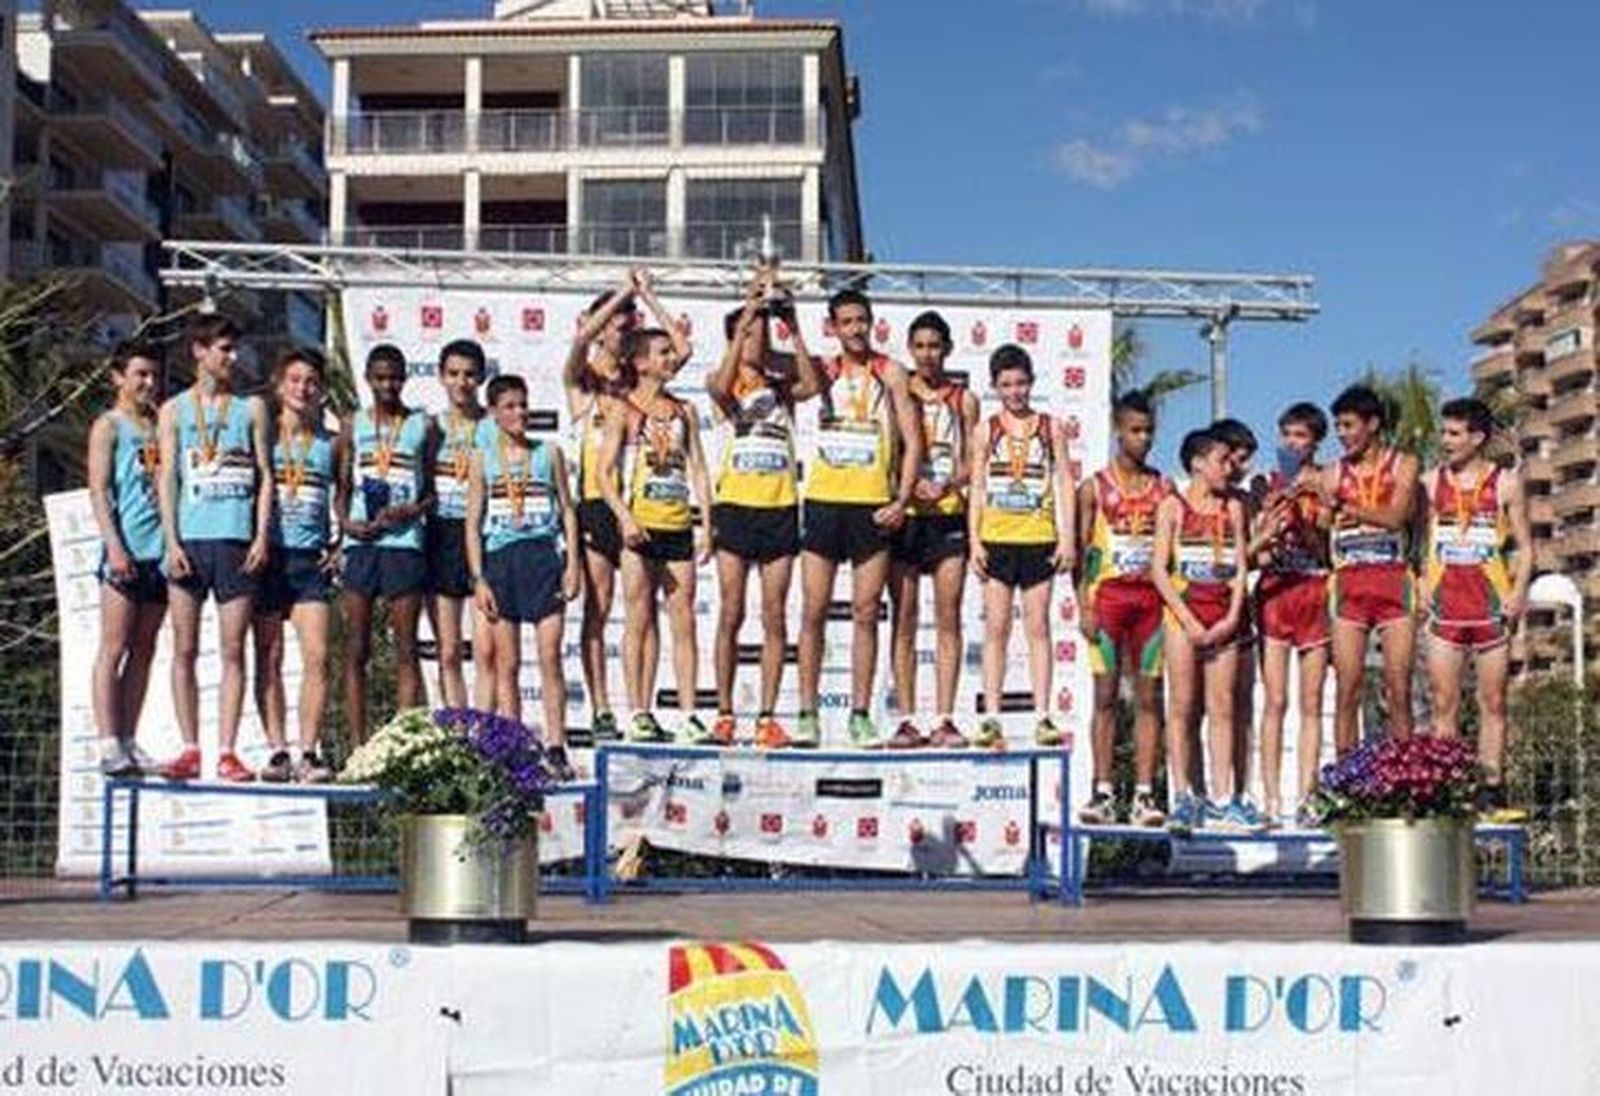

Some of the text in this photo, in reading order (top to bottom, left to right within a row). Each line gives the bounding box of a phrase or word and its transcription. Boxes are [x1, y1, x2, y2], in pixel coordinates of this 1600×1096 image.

[200, 957, 377, 1021] D'OR
[866, 963, 1387, 1034] MARINA D'OR
[673, 993, 805, 1056] MARINA
[35, 1055, 78, 1088] de
[92, 1055, 286, 1088] Vacaciones
[946, 1065, 1304, 1096] Ciudad de Vacaciones
